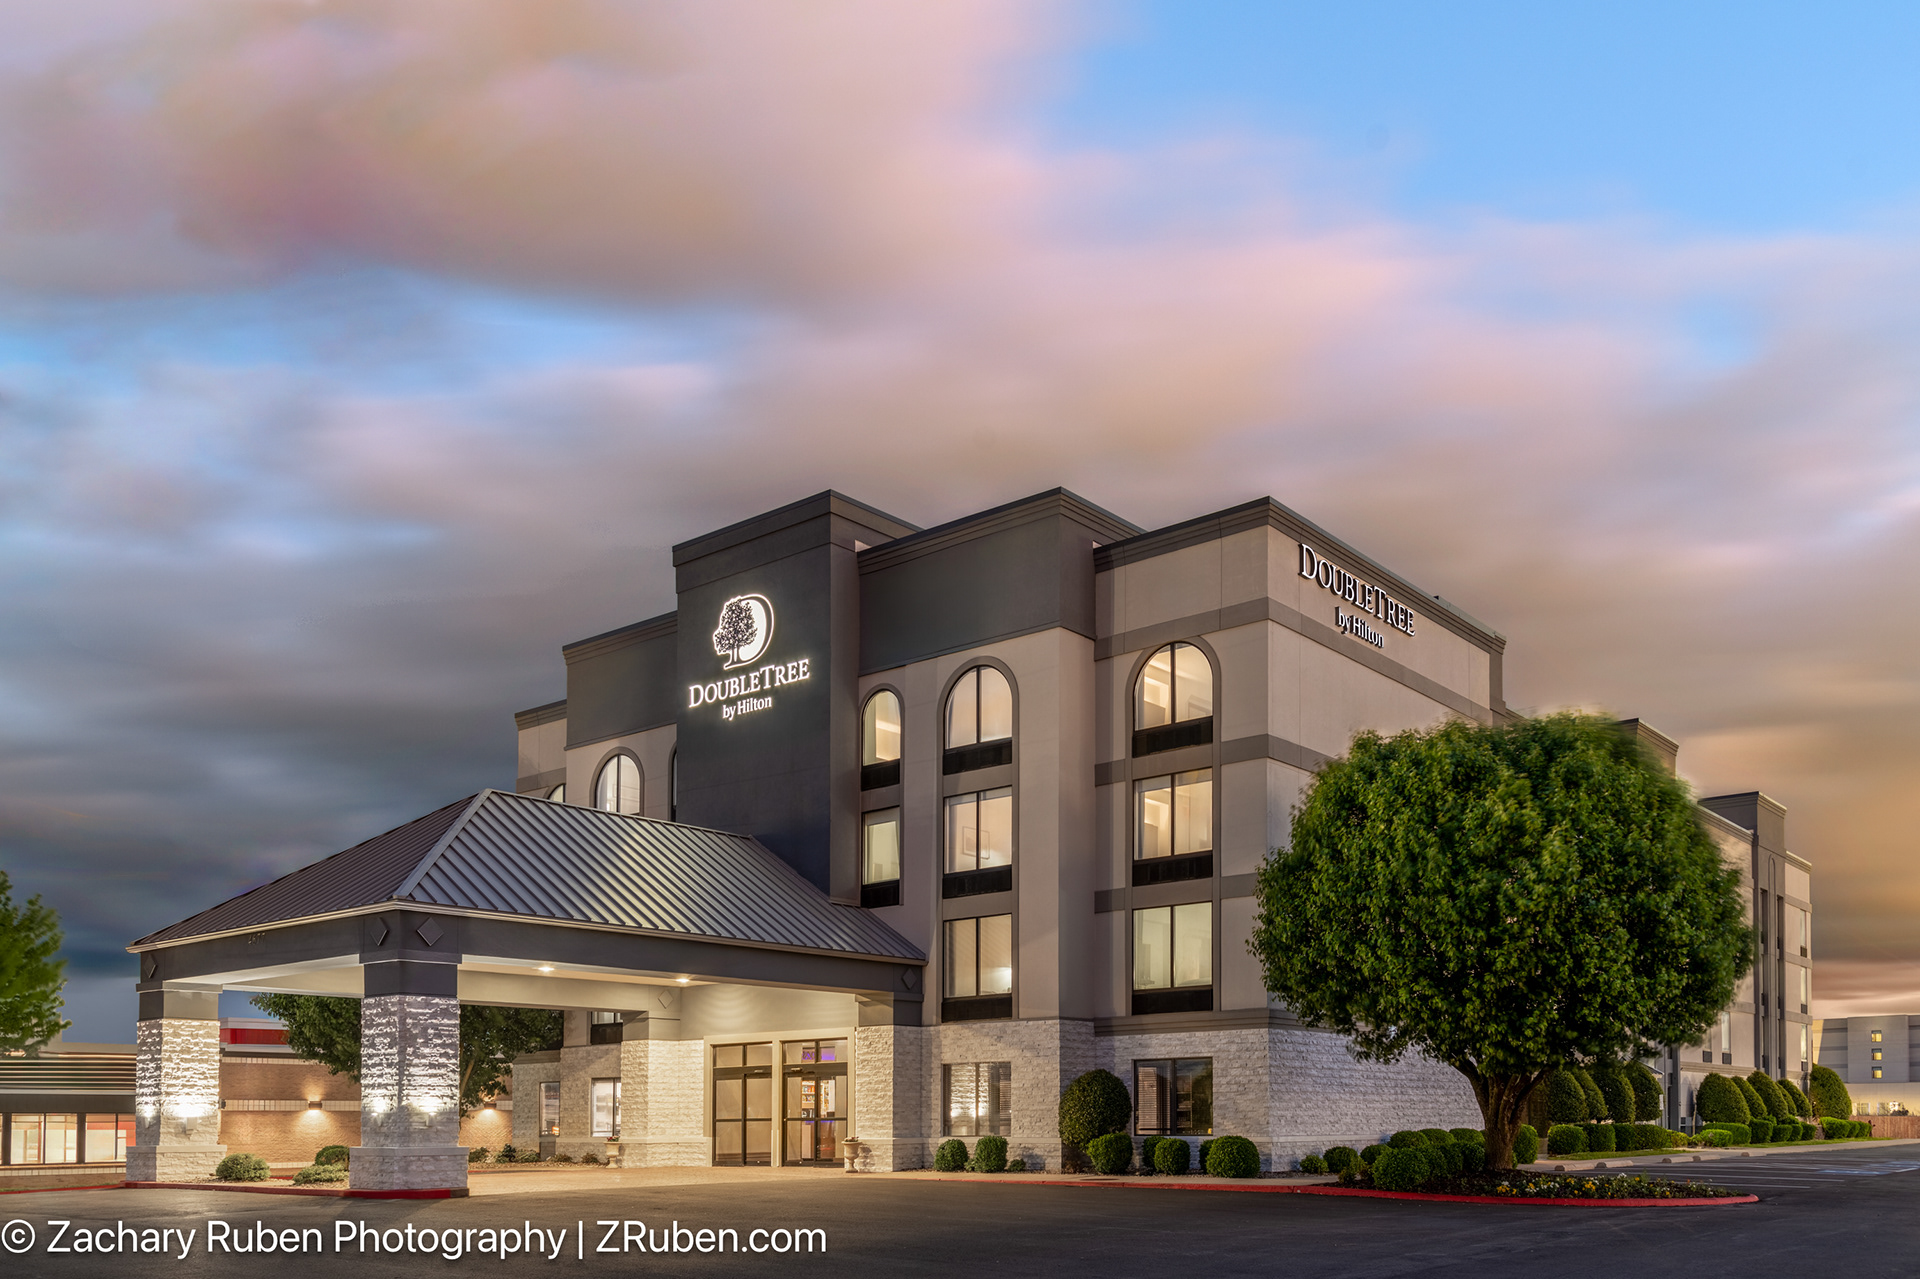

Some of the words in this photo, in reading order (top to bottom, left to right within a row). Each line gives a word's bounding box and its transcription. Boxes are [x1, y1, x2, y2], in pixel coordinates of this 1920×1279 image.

[1335, 606, 1350, 634] by
[1351, 615, 1384, 648] Hilton
[722, 704, 736, 721] by
[737, 697, 772, 715] Hilton
